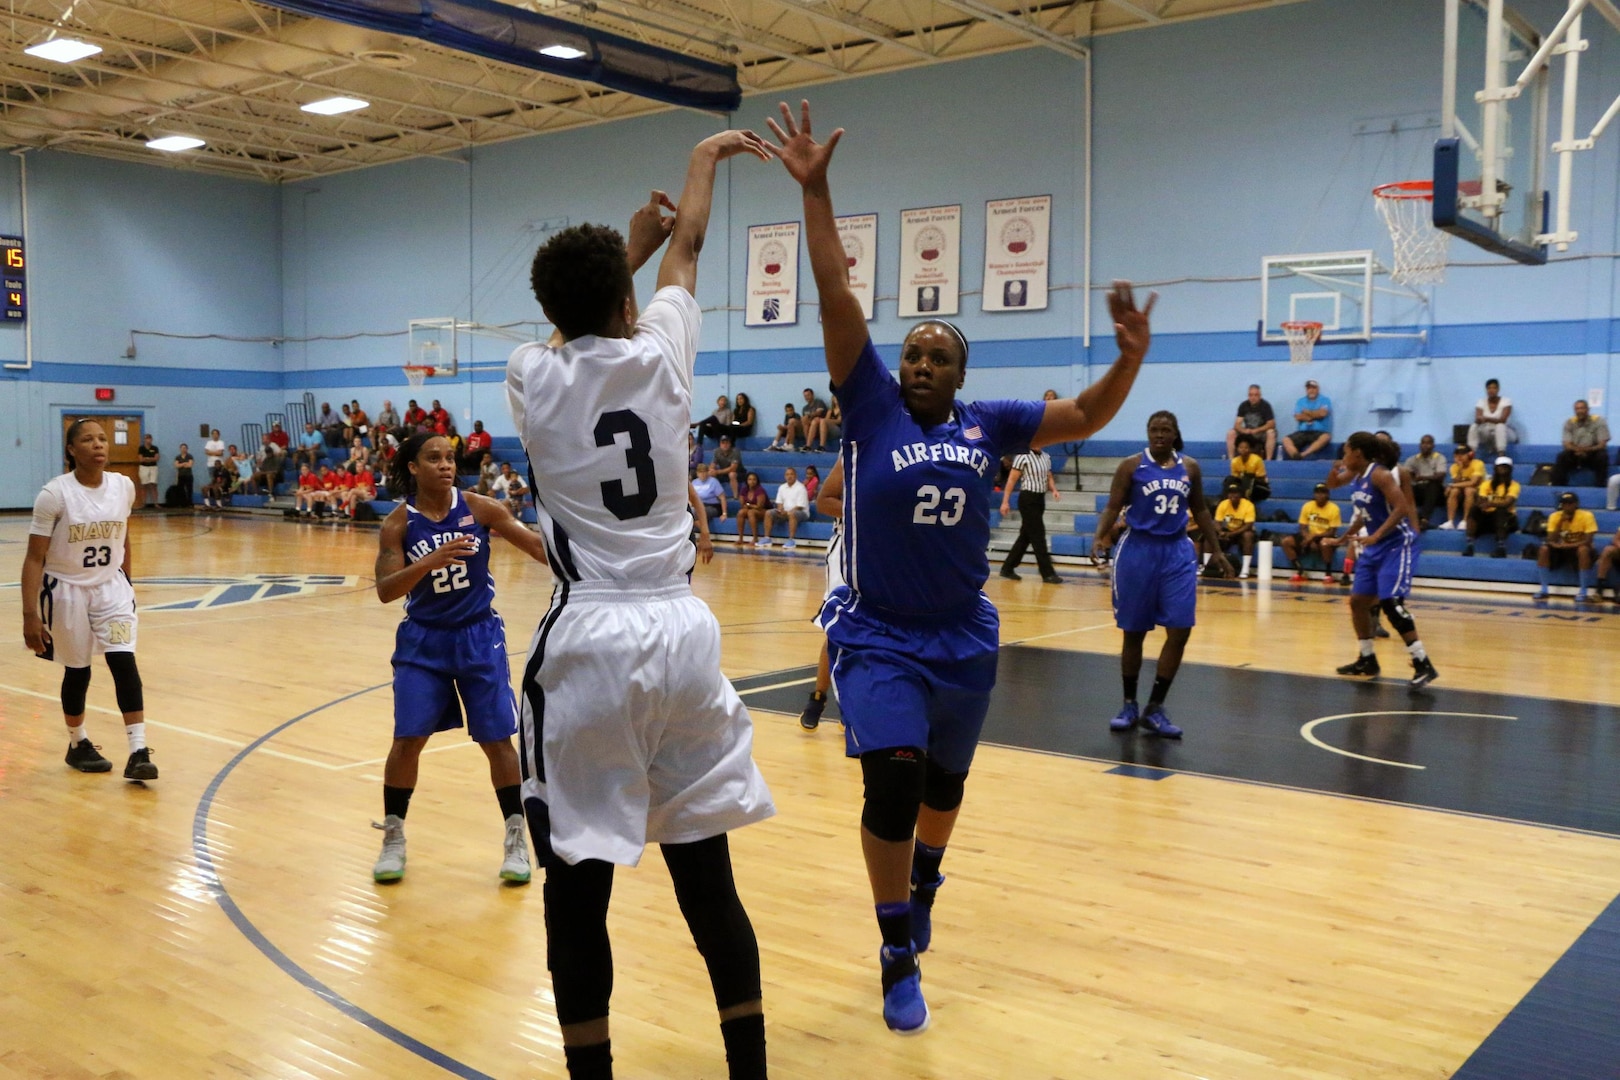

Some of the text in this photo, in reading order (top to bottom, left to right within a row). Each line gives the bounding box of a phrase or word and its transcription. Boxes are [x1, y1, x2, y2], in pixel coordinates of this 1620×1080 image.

[906, 214, 956, 224] Armed Forces
[993, 205, 1045, 215] Armed Forces
[774, 230, 795, 238] Forces
[6, 248, 25, 268] 15
[10, 292, 21, 306] 4
[593, 409, 658, 521] 3
[891, 442, 989, 478] AIR FORCE
[1142, 479, 1161, 496] AIR
[912, 484, 967, 526] 23
[1154, 494, 1180, 515] 34
[83, 545, 112, 568] 23
[430, 560, 471, 594] 22
[108, 620, 132, 645] N
